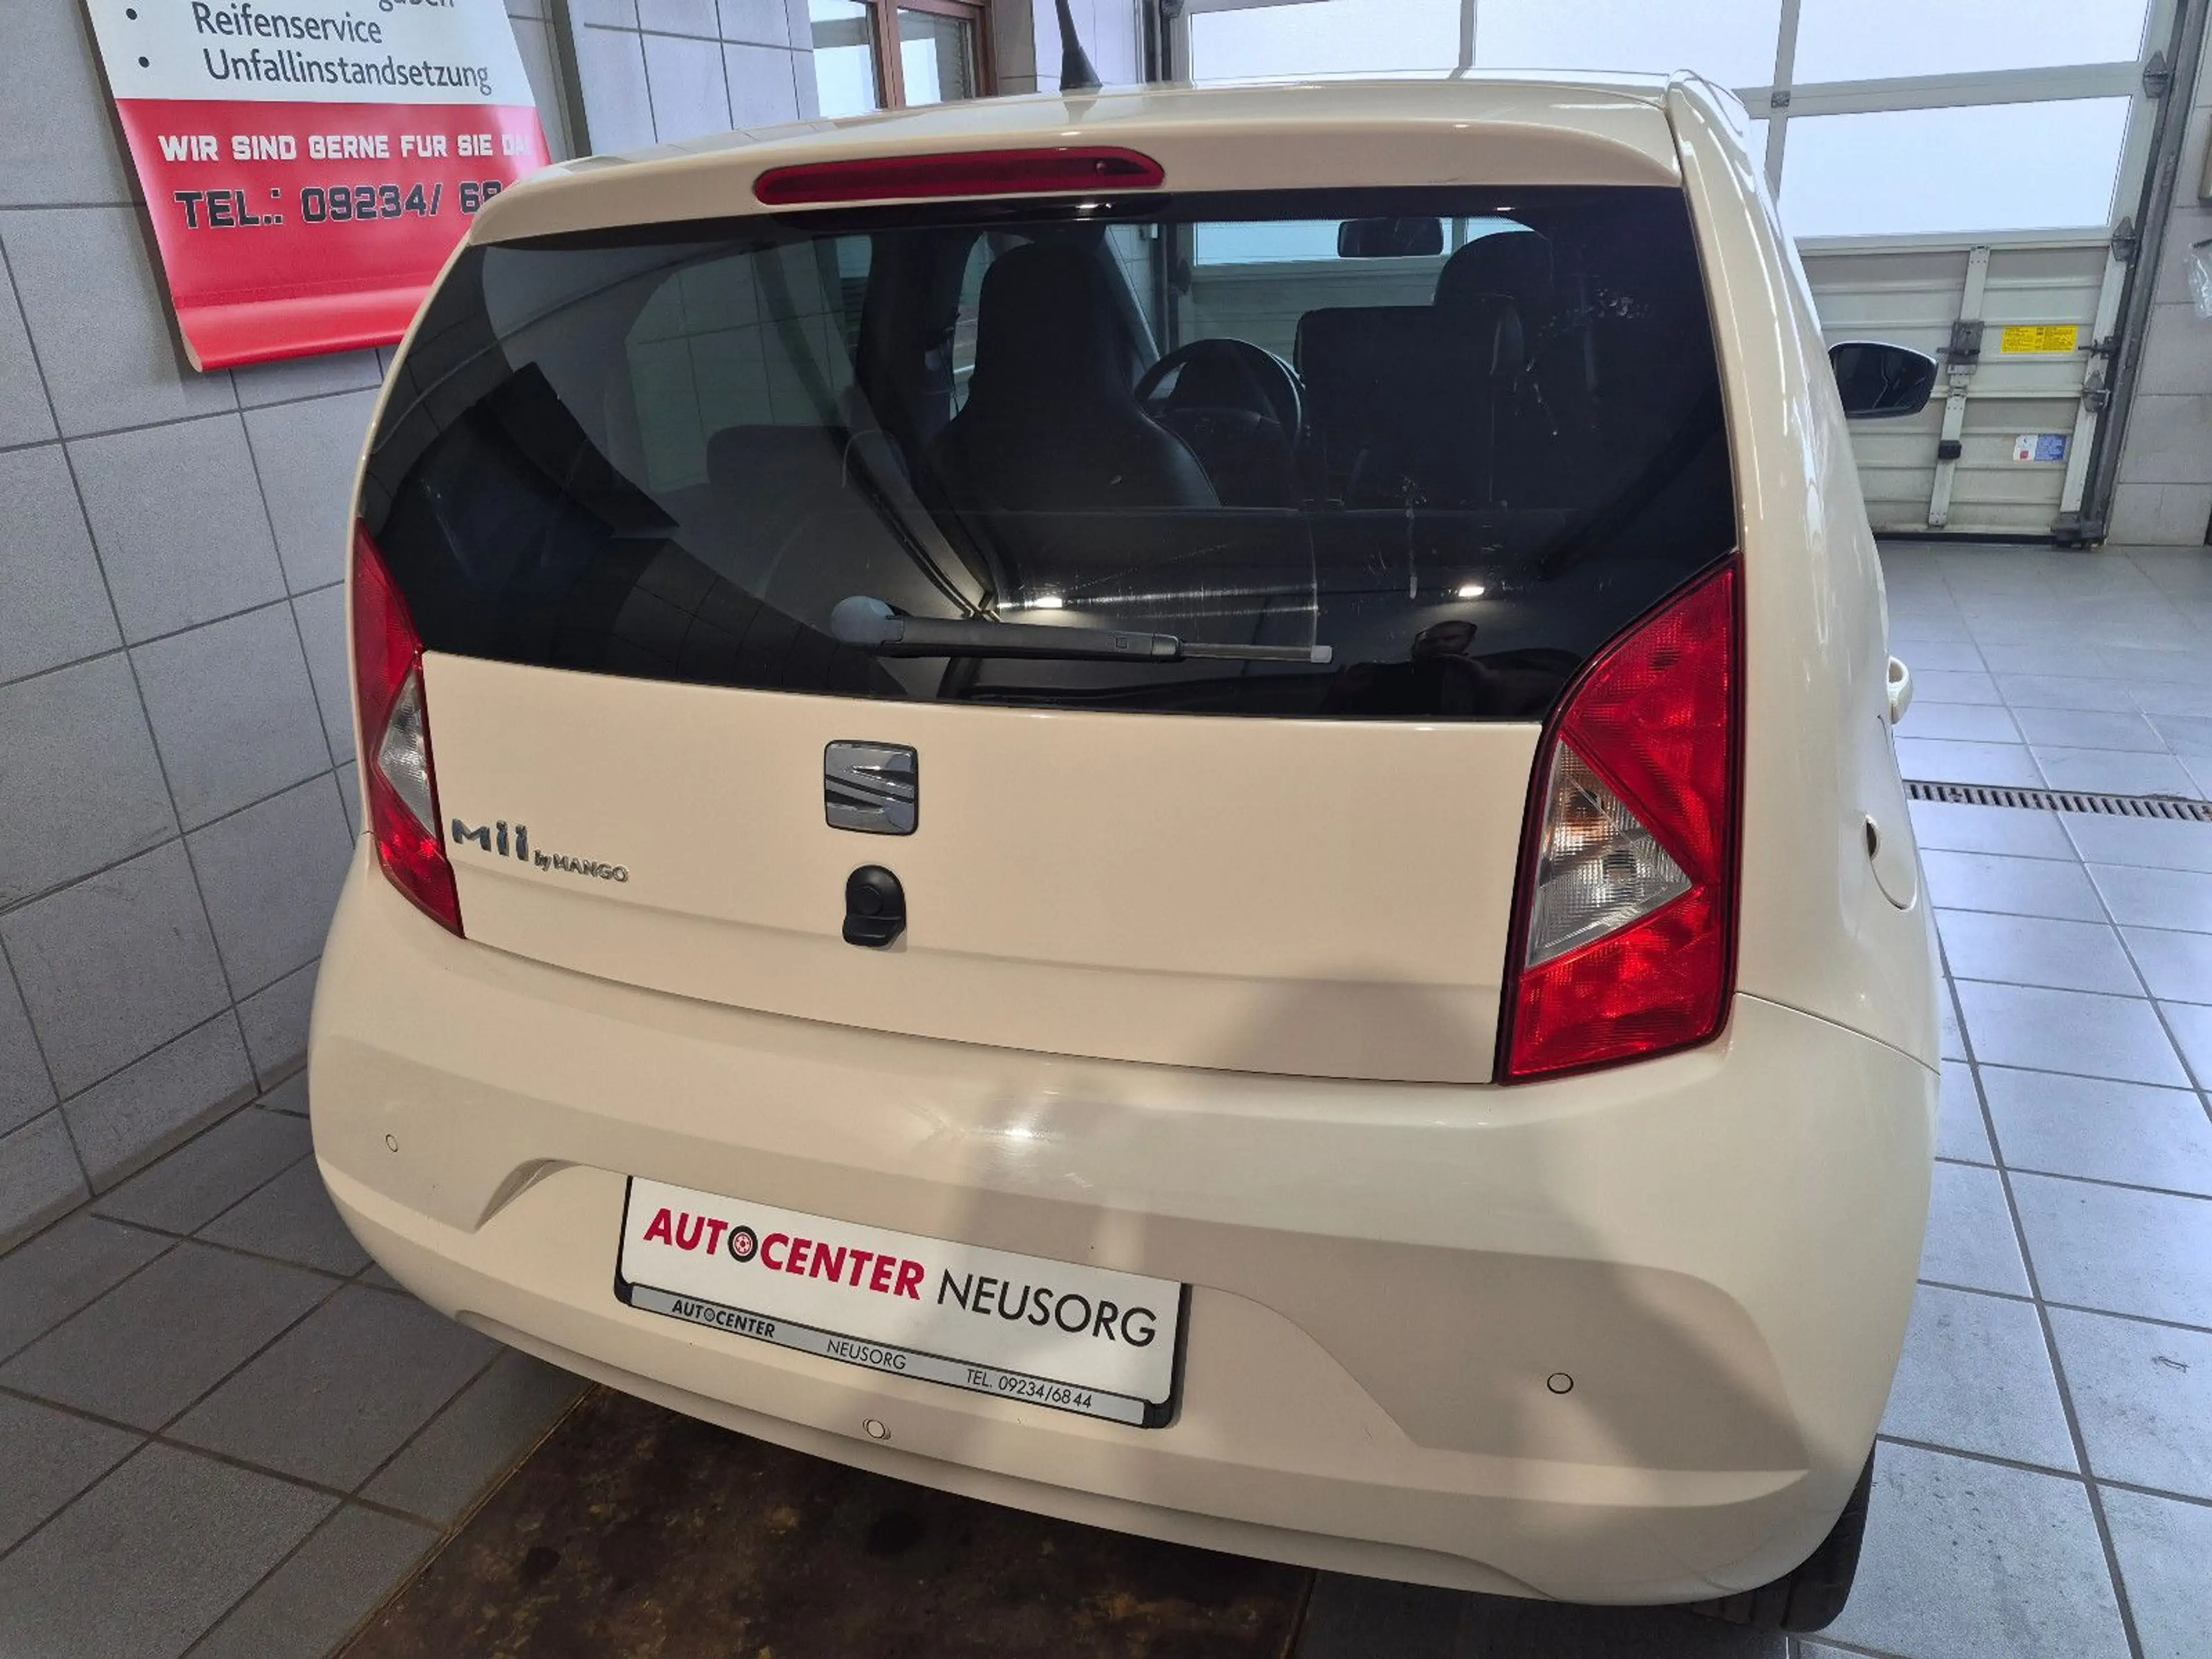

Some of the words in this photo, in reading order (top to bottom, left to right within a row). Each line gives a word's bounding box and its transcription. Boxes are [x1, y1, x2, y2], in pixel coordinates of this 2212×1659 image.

[192, 1, 382, 44] Reifenservice
[203, 48, 491, 96] Unfallinstandsetzung
[157, 135, 219, 161] WIR
[231, 135, 297, 161] SIND
[308, 134, 390, 160] GERNE
[457, 134, 493, 157] SIE
[301, 181, 443, 224] 09234/
[452, 818, 529, 862] Mii
[534, 849, 552, 872] by
[553, 853, 629, 883] MANGO
[643, 1207, 925, 1301] AUTOCENTER
[937, 1268, 1157, 1347] NEUSORG
[672, 1299, 775, 1338] AUTOCENTER
[826, 1339, 907, 1370] NEUSORG
[966, 1368, 993, 1389] TEL.
